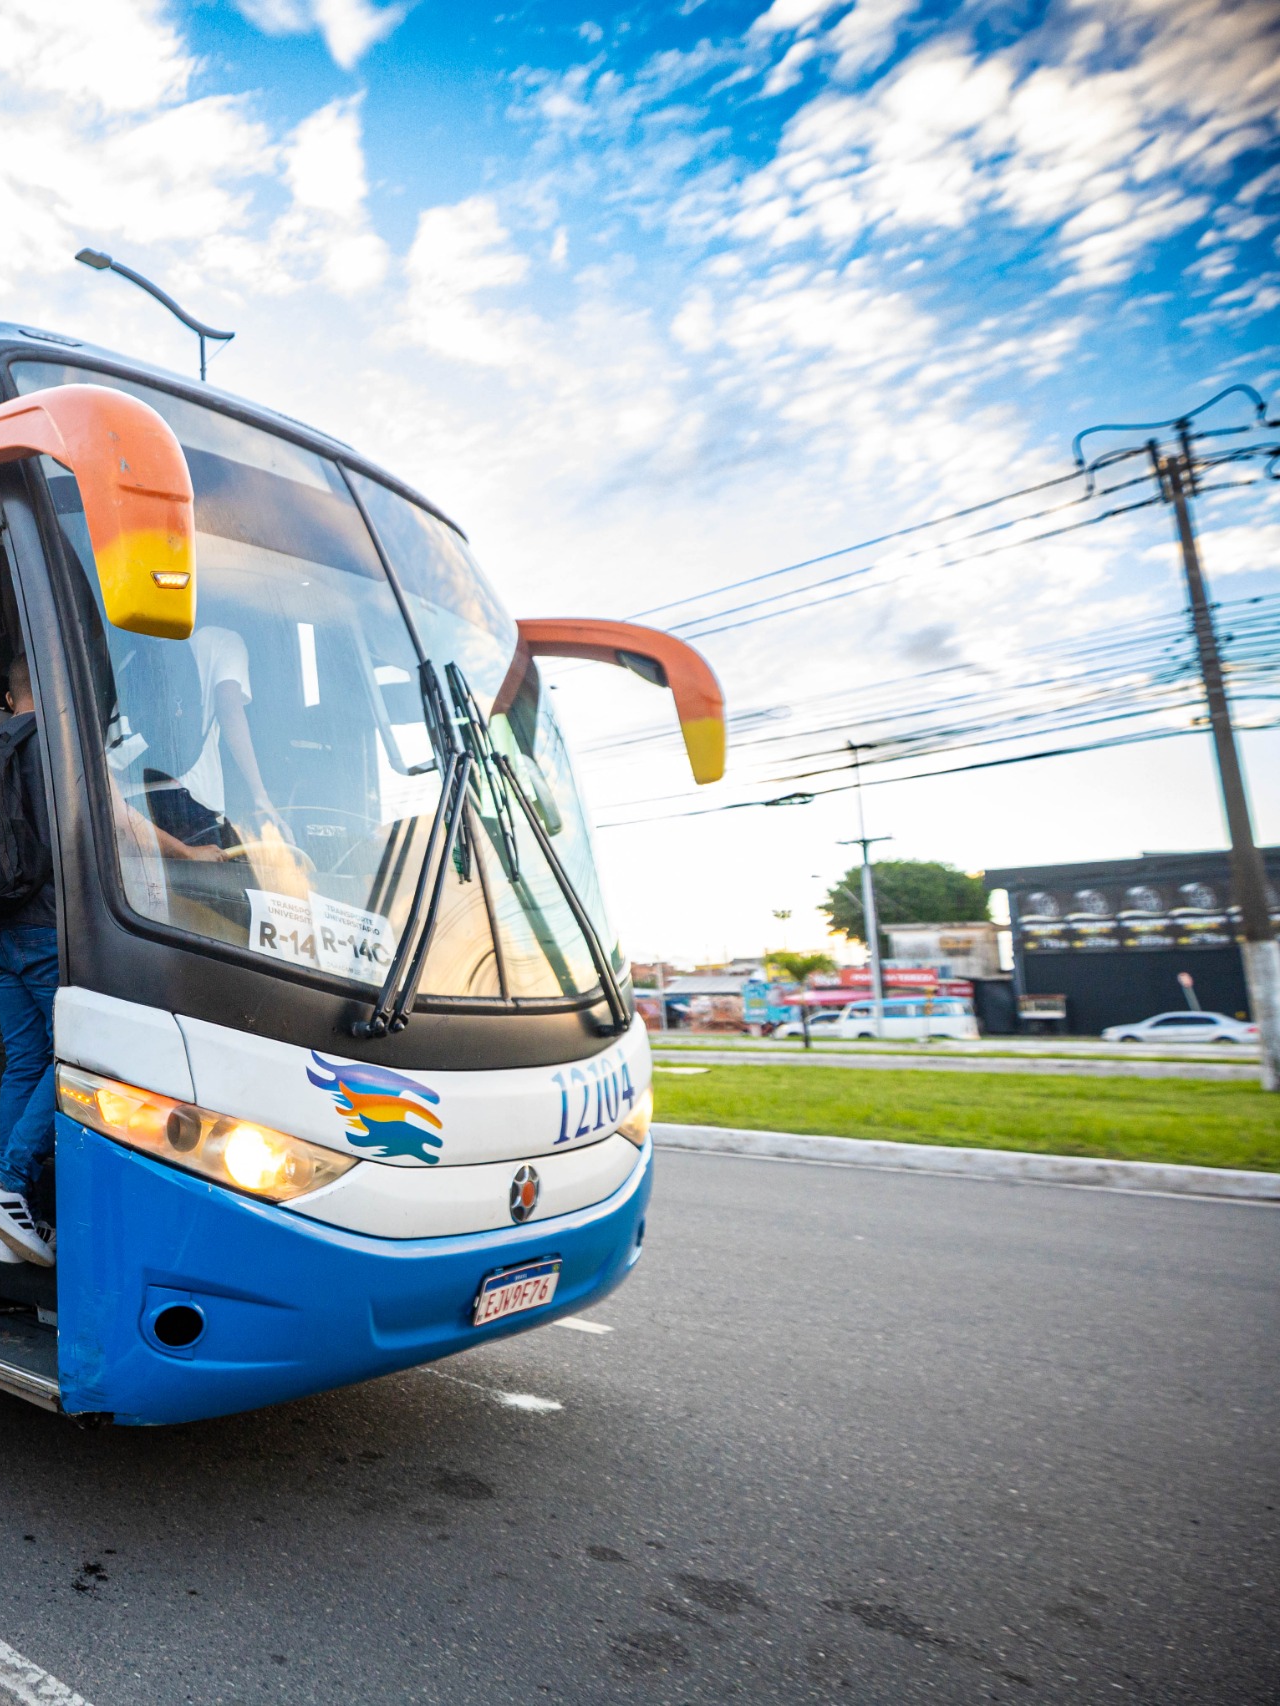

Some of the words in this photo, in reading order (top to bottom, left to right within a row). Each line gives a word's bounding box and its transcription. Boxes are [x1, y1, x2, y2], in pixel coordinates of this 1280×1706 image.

[325, 904, 373, 925] TRANSPORTE
[259, 920, 316, 960] R-14
[320, 926, 391, 966] R-14C
[551, 1048, 634, 1145] 12104
[484, 1278, 550, 1318] EJW9F76
